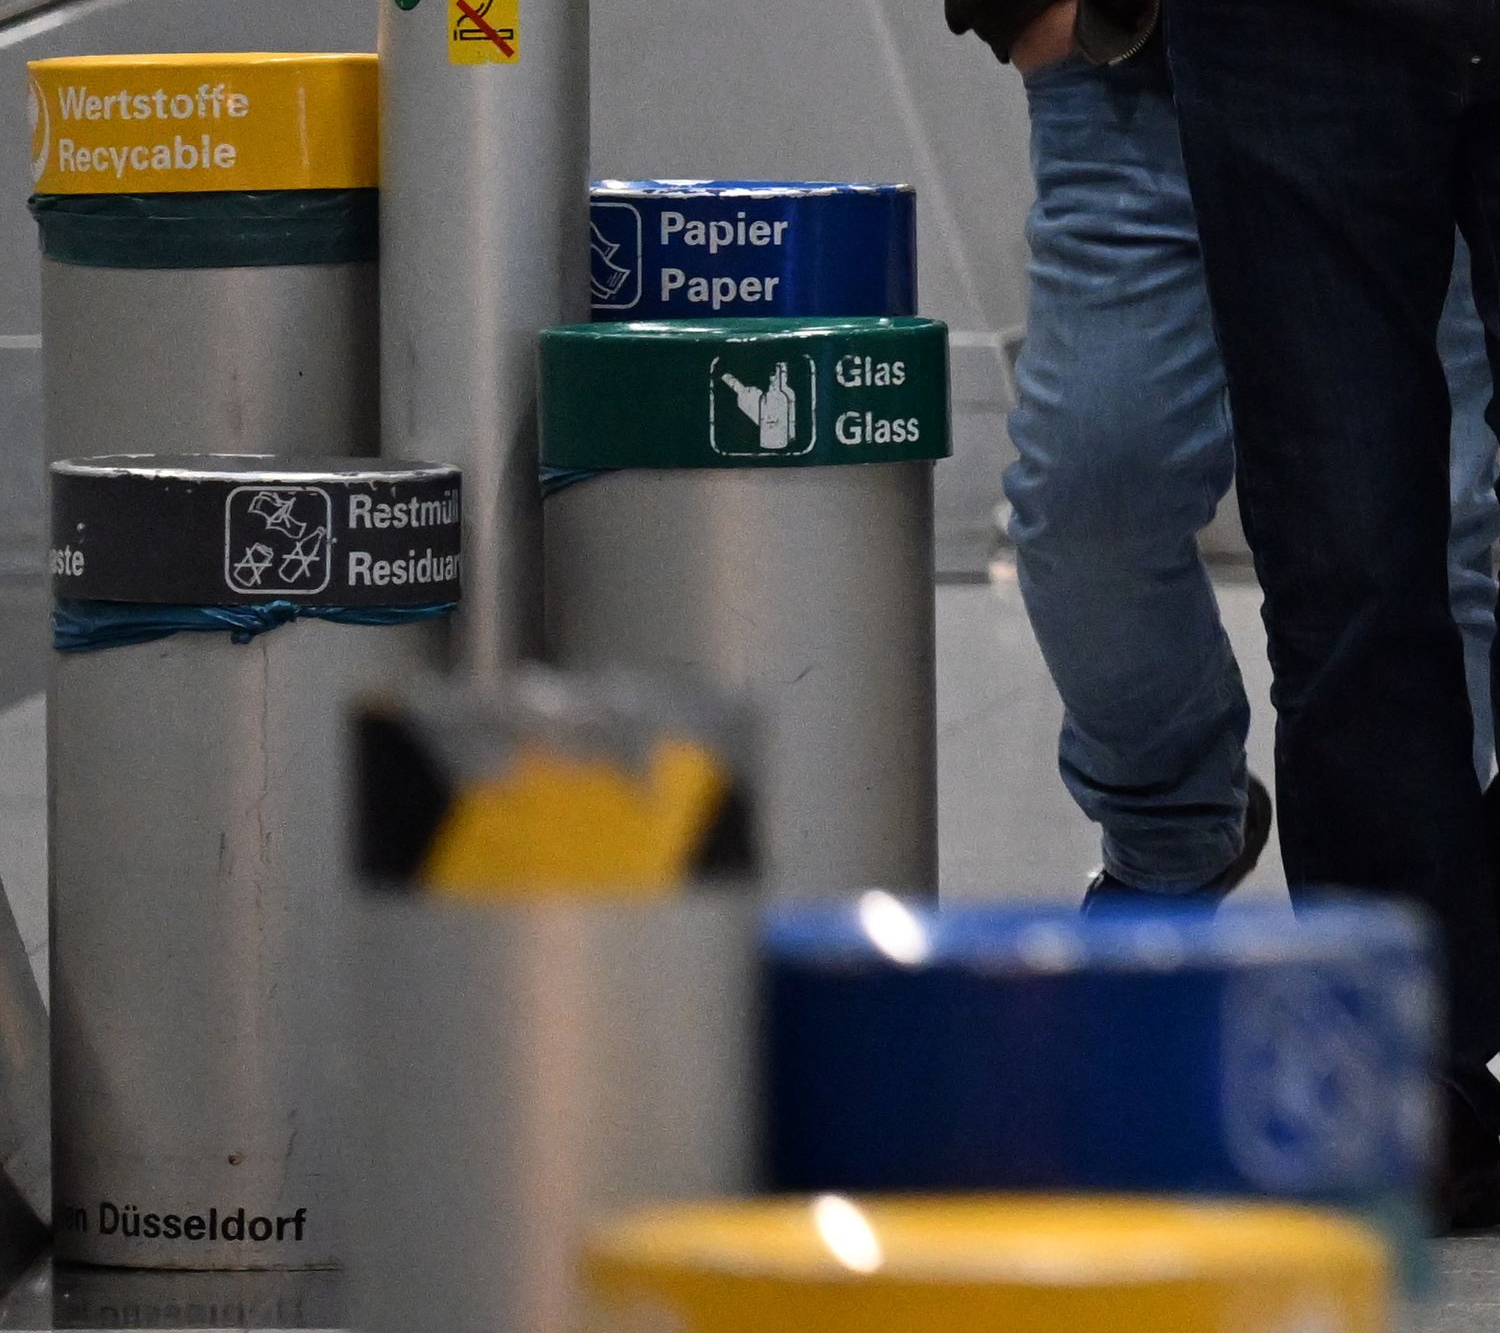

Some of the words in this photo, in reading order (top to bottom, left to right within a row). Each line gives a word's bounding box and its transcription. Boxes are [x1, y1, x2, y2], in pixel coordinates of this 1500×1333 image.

[58, 83, 250, 120] Wertstoffe
[58, 133, 238, 179] Recycable
[660, 211, 790, 254] Papier
[660, 267, 780, 310] Paper
[835, 354, 906, 388] Glas
[835, 411, 920, 446] Glass
[100, 1201, 308, 1242] Düsseldorf
